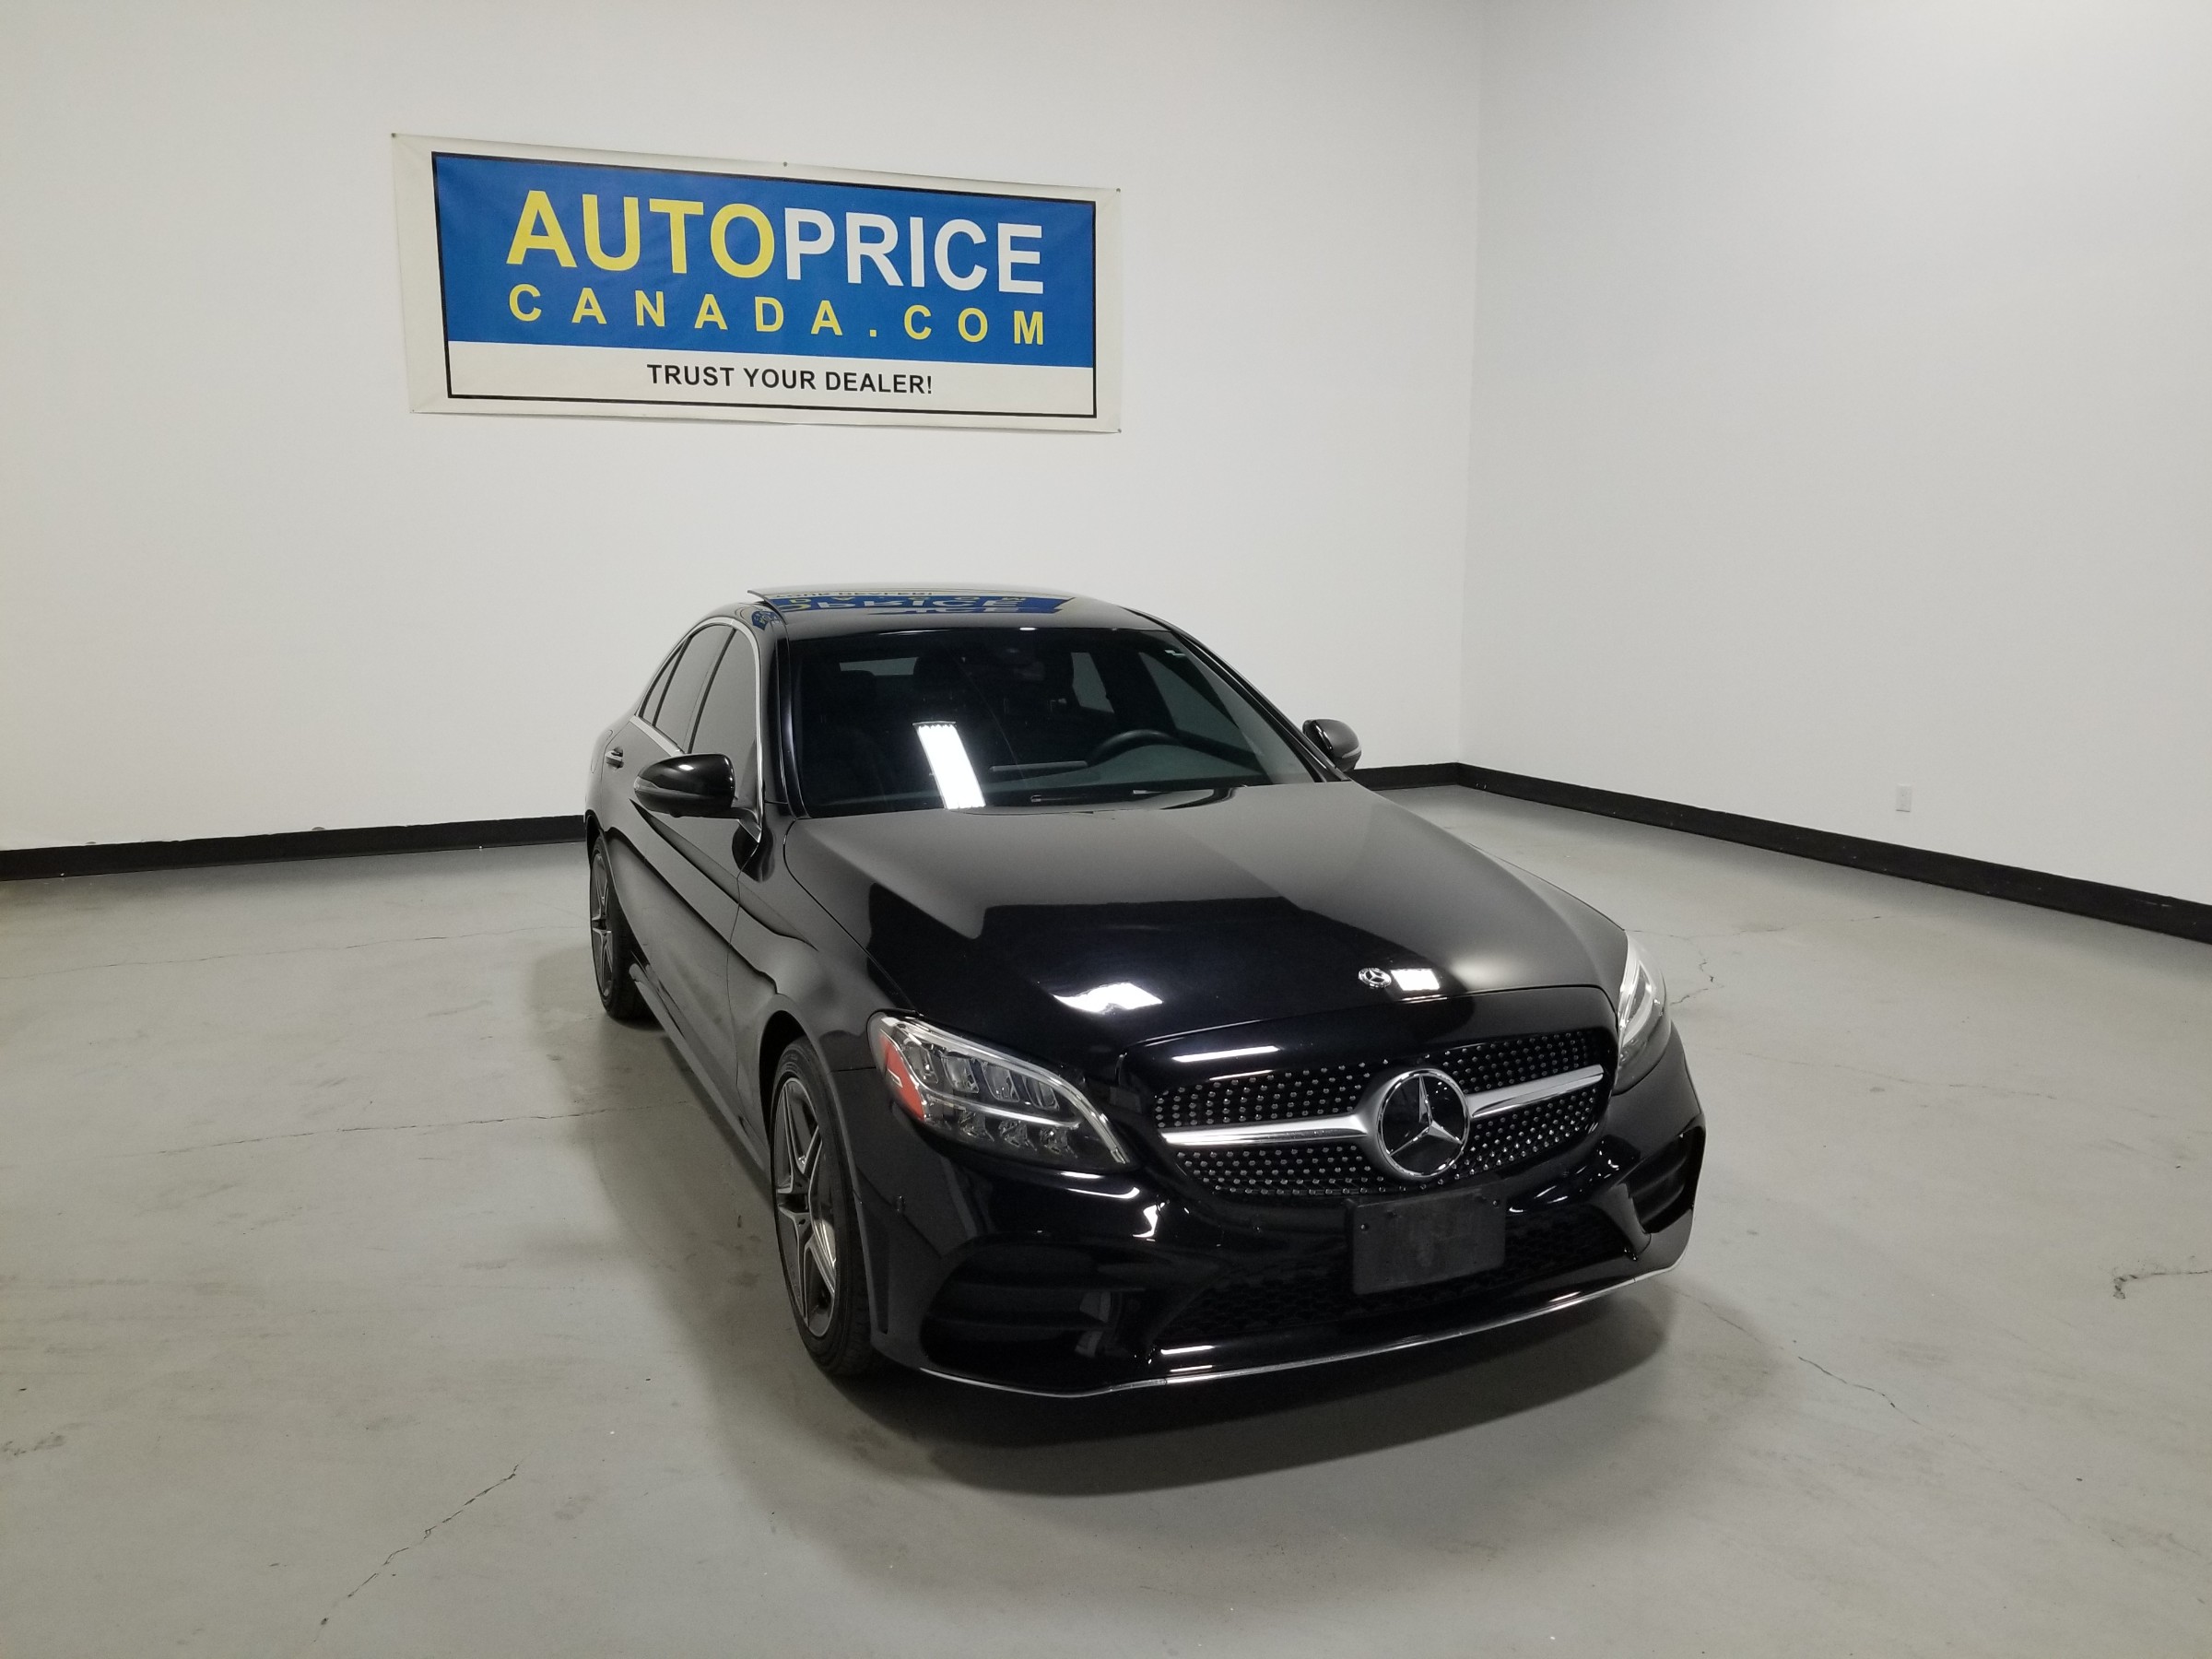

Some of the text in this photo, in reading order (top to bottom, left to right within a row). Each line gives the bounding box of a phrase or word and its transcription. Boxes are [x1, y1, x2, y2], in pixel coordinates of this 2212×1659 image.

[507, 190, 1043, 294] AUTOPRICE
[647, 363, 933, 394] TRUST YOUR DEALER!
